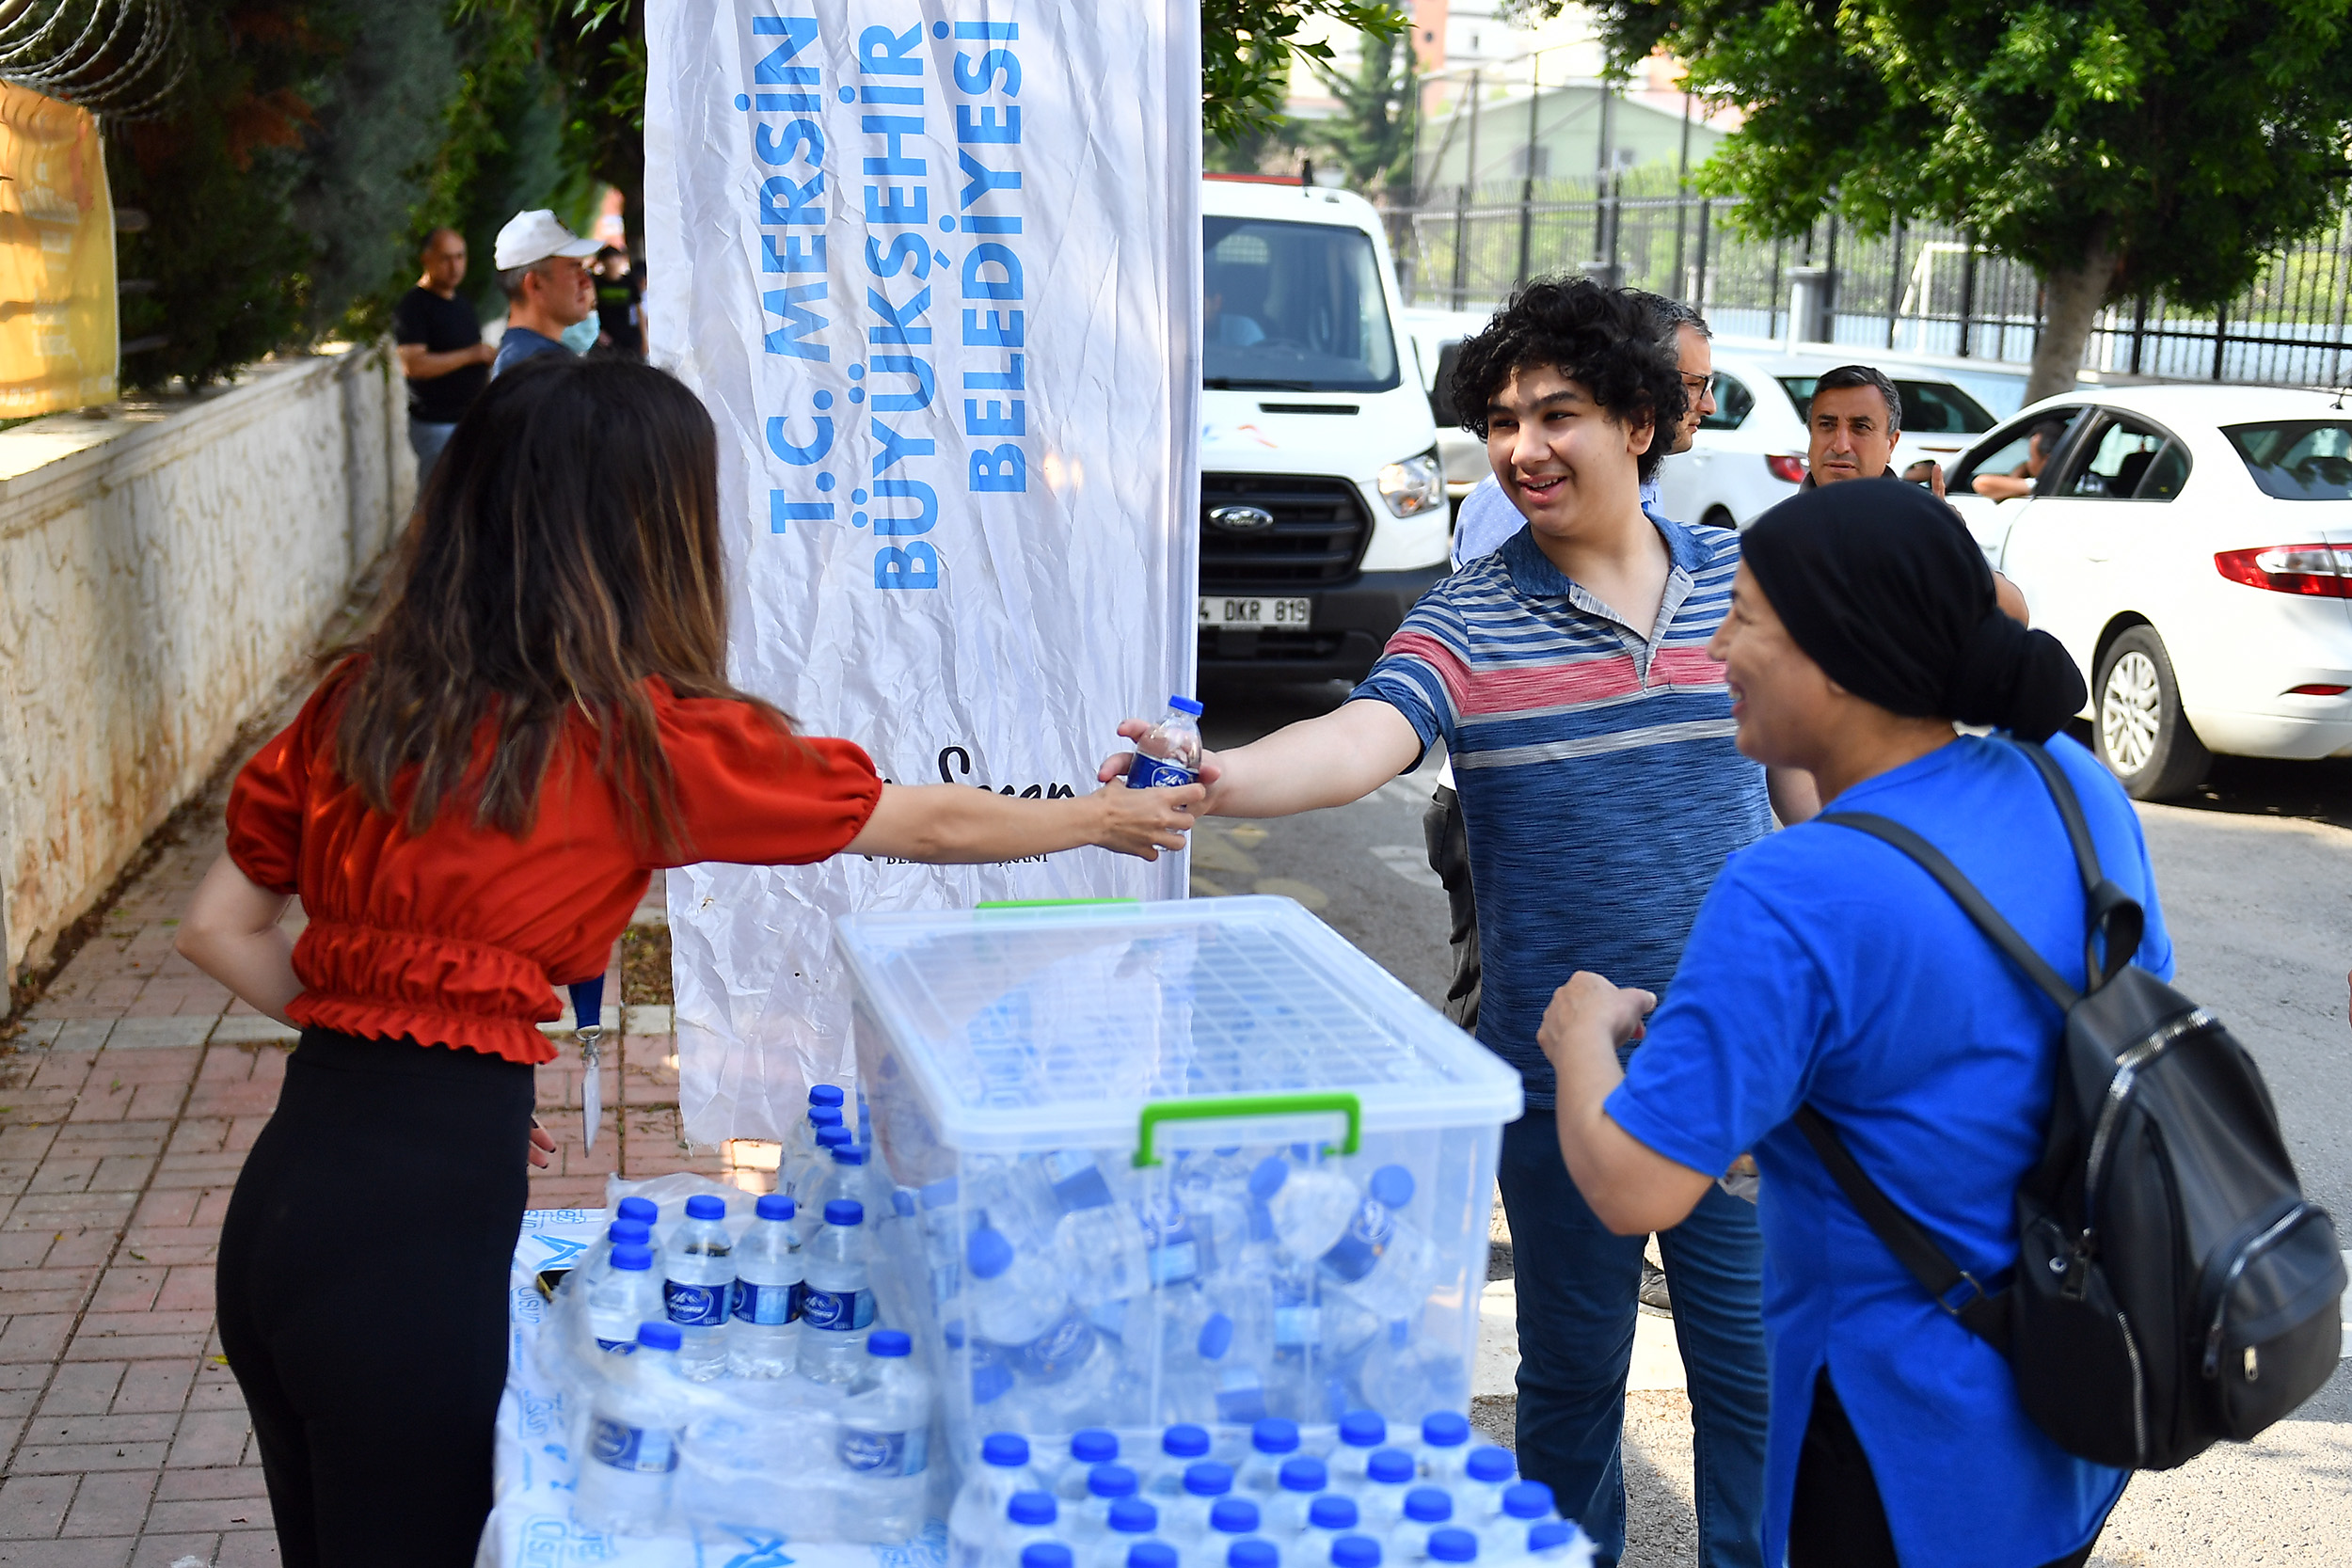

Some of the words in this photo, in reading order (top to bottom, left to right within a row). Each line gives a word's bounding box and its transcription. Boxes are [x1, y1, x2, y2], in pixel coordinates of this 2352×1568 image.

[734, 16, 830, 362] MERSİN
[837, 21, 950, 590] BÜYÜKŞEHİR
[932, 20, 1026, 493] BELEDİYESİ
[766, 389, 835, 534] T.C.
[1225, 600, 1260, 621] DKR
[1276, 600, 1306, 621] 819
